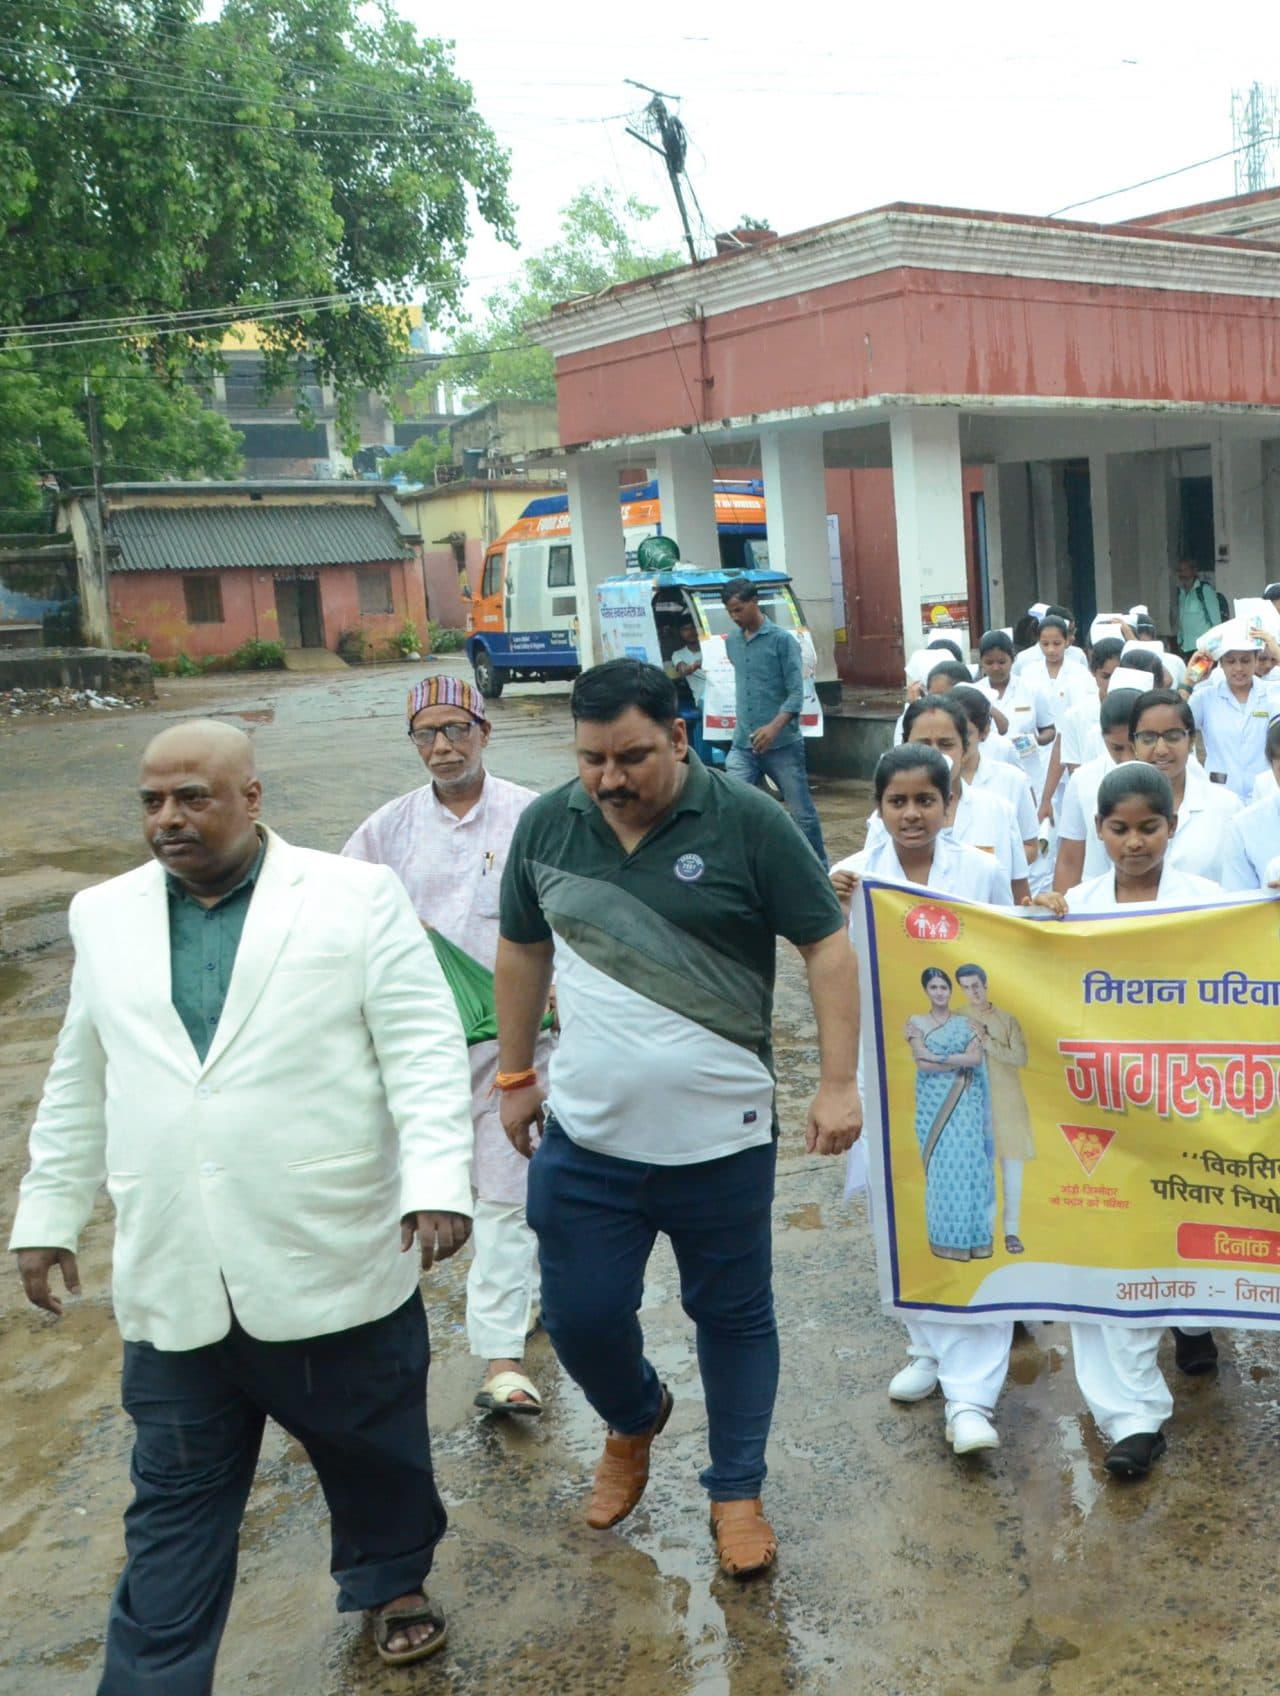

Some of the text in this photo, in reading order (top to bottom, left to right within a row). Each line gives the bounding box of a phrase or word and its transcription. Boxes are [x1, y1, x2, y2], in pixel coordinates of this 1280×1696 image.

[1083, 970, 1187, 1004] मिशन
[1151, 1174, 1225, 1205] परिवार
[1215, 1231, 1270, 1258] दिनांक
[1117, 1276, 1197, 1301] आयोजक
[1235, 1278, 1280, 1305] जिला
